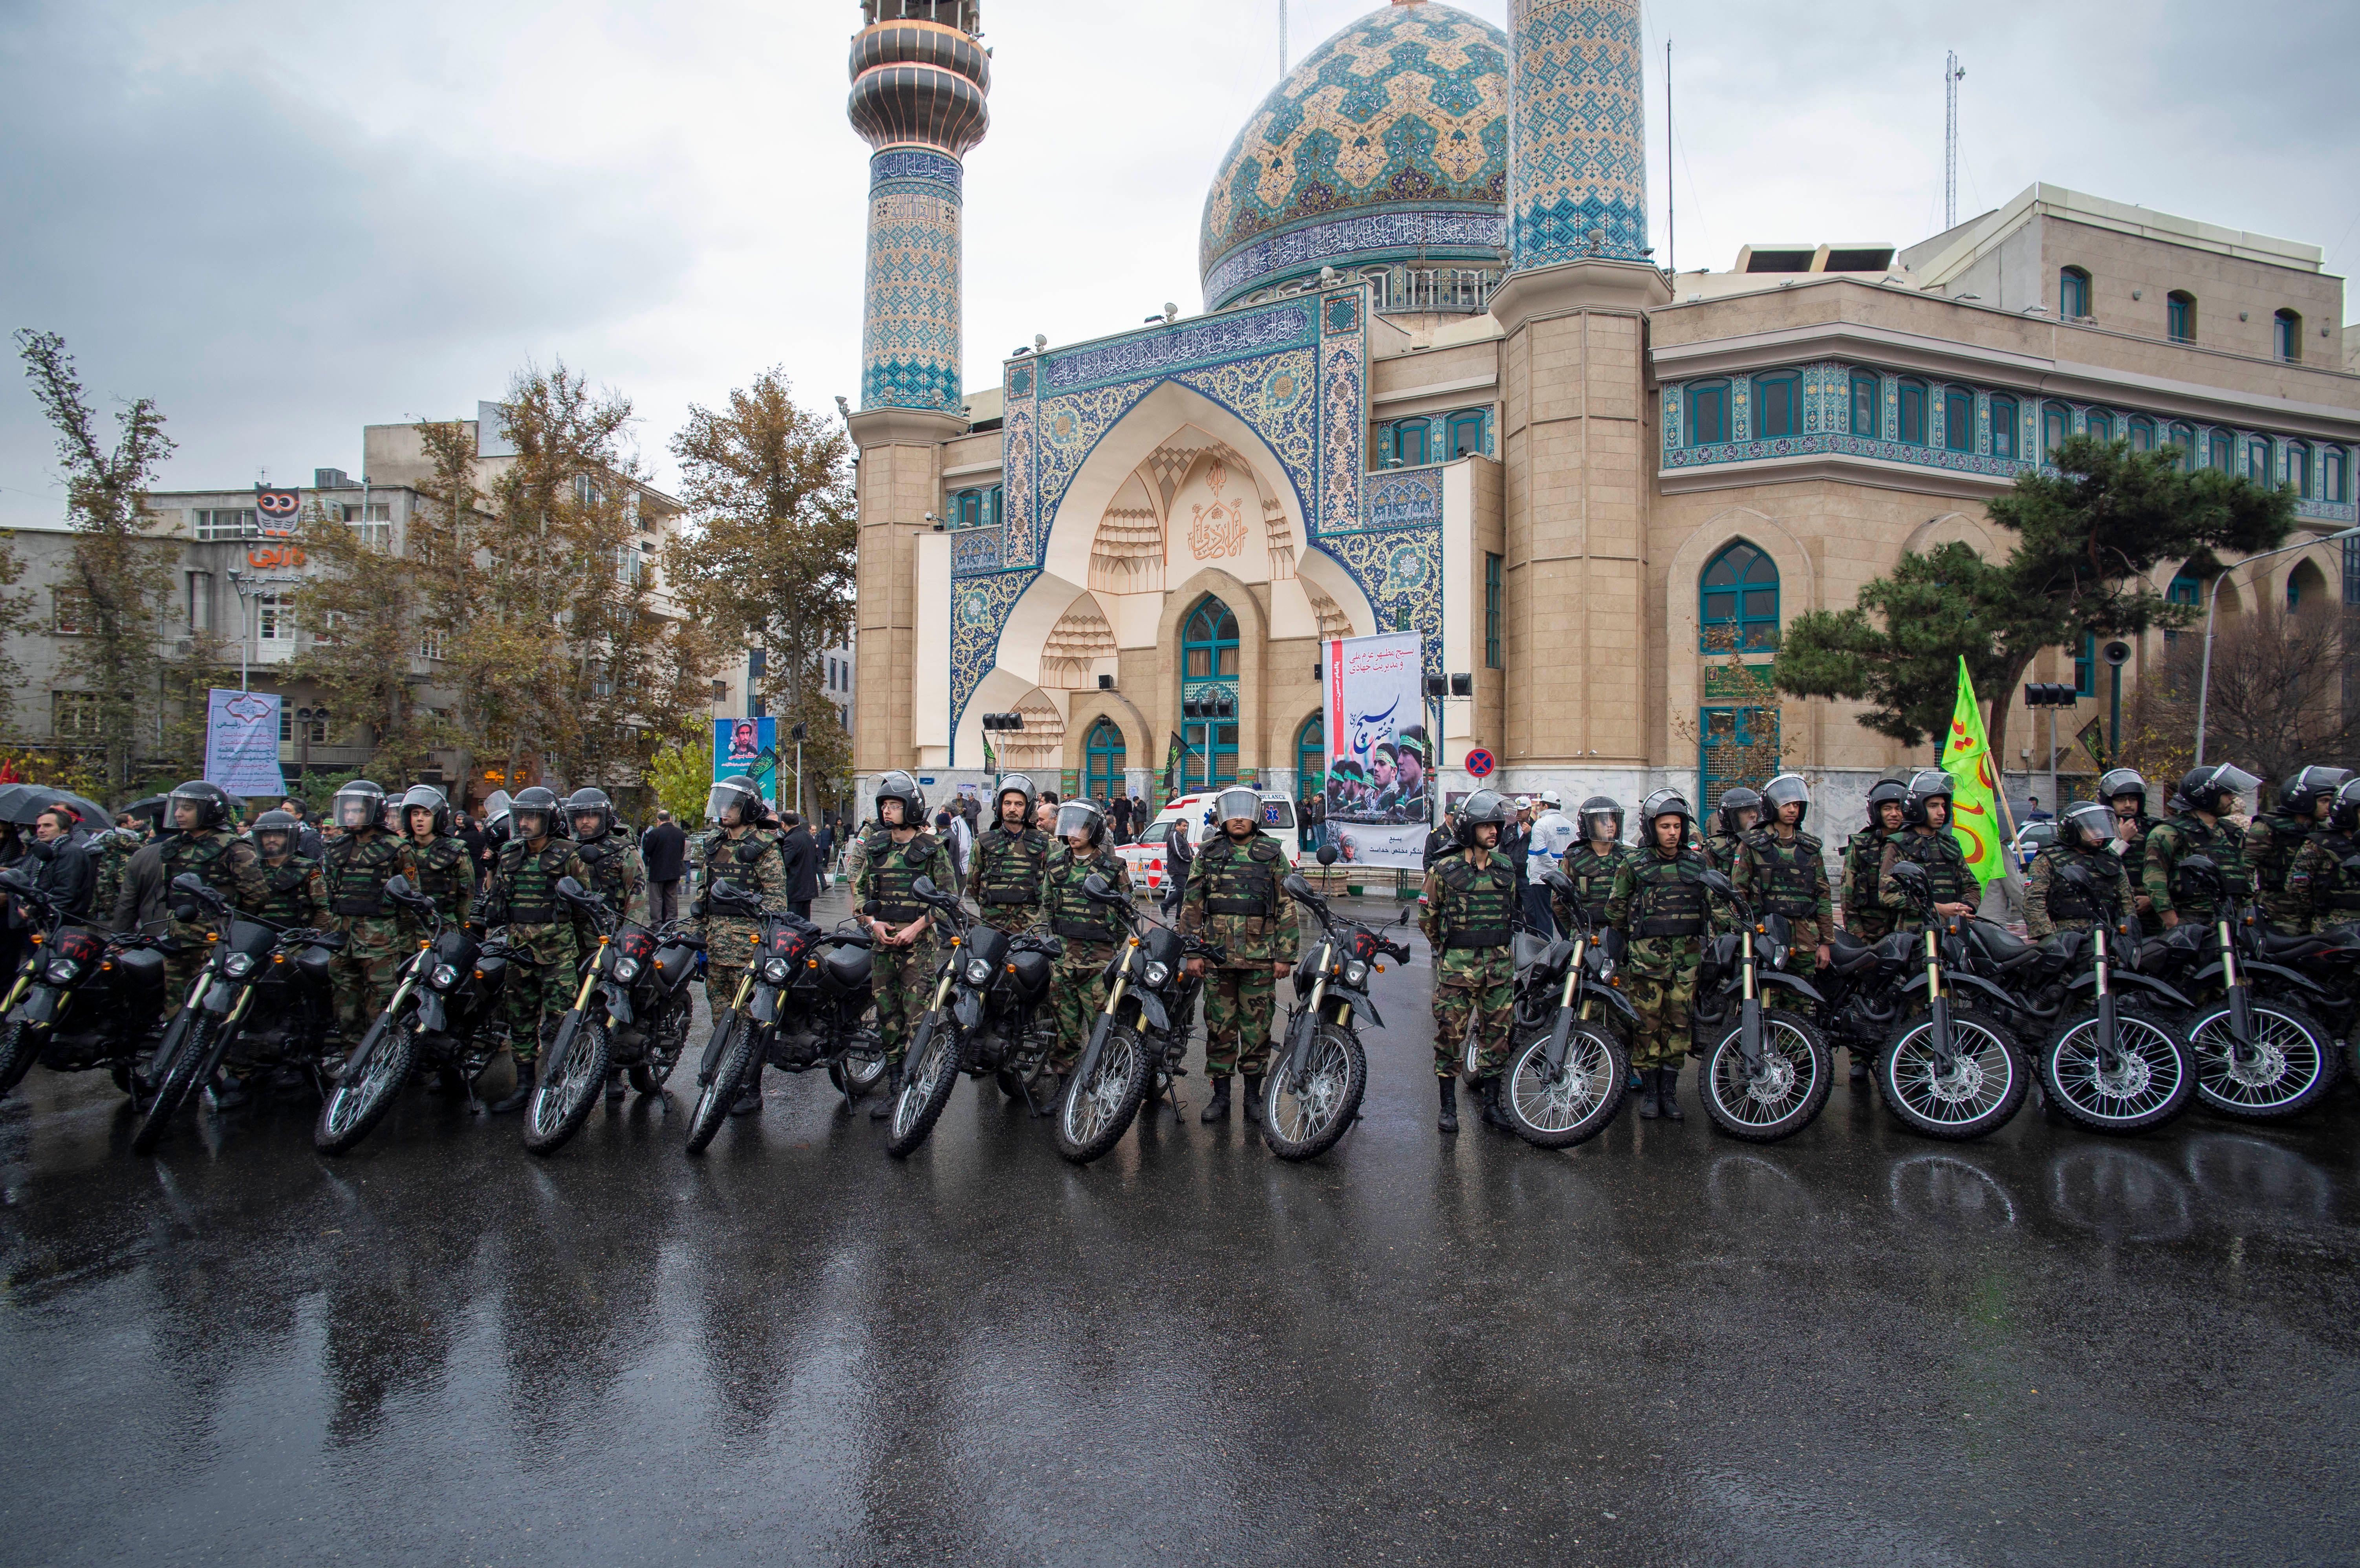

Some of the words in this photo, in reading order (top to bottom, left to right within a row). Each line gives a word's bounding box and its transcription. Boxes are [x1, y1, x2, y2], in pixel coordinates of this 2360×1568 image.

[1349, 651, 1360, 664] ملی
[1362, 652, 1374, 663] عزم
[1375, 648, 1394, 661] مظهر
[1396, 648, 1414, 659] بسیج
[1349, 662, 1371, 675] جهادی
[1373, 661, 1398, 673] مدیریت
[1399, 661, 1404, 671] و
[1353, 693, 1399, 754] بسیج
[1375, 722, 1392, 741] هفته
